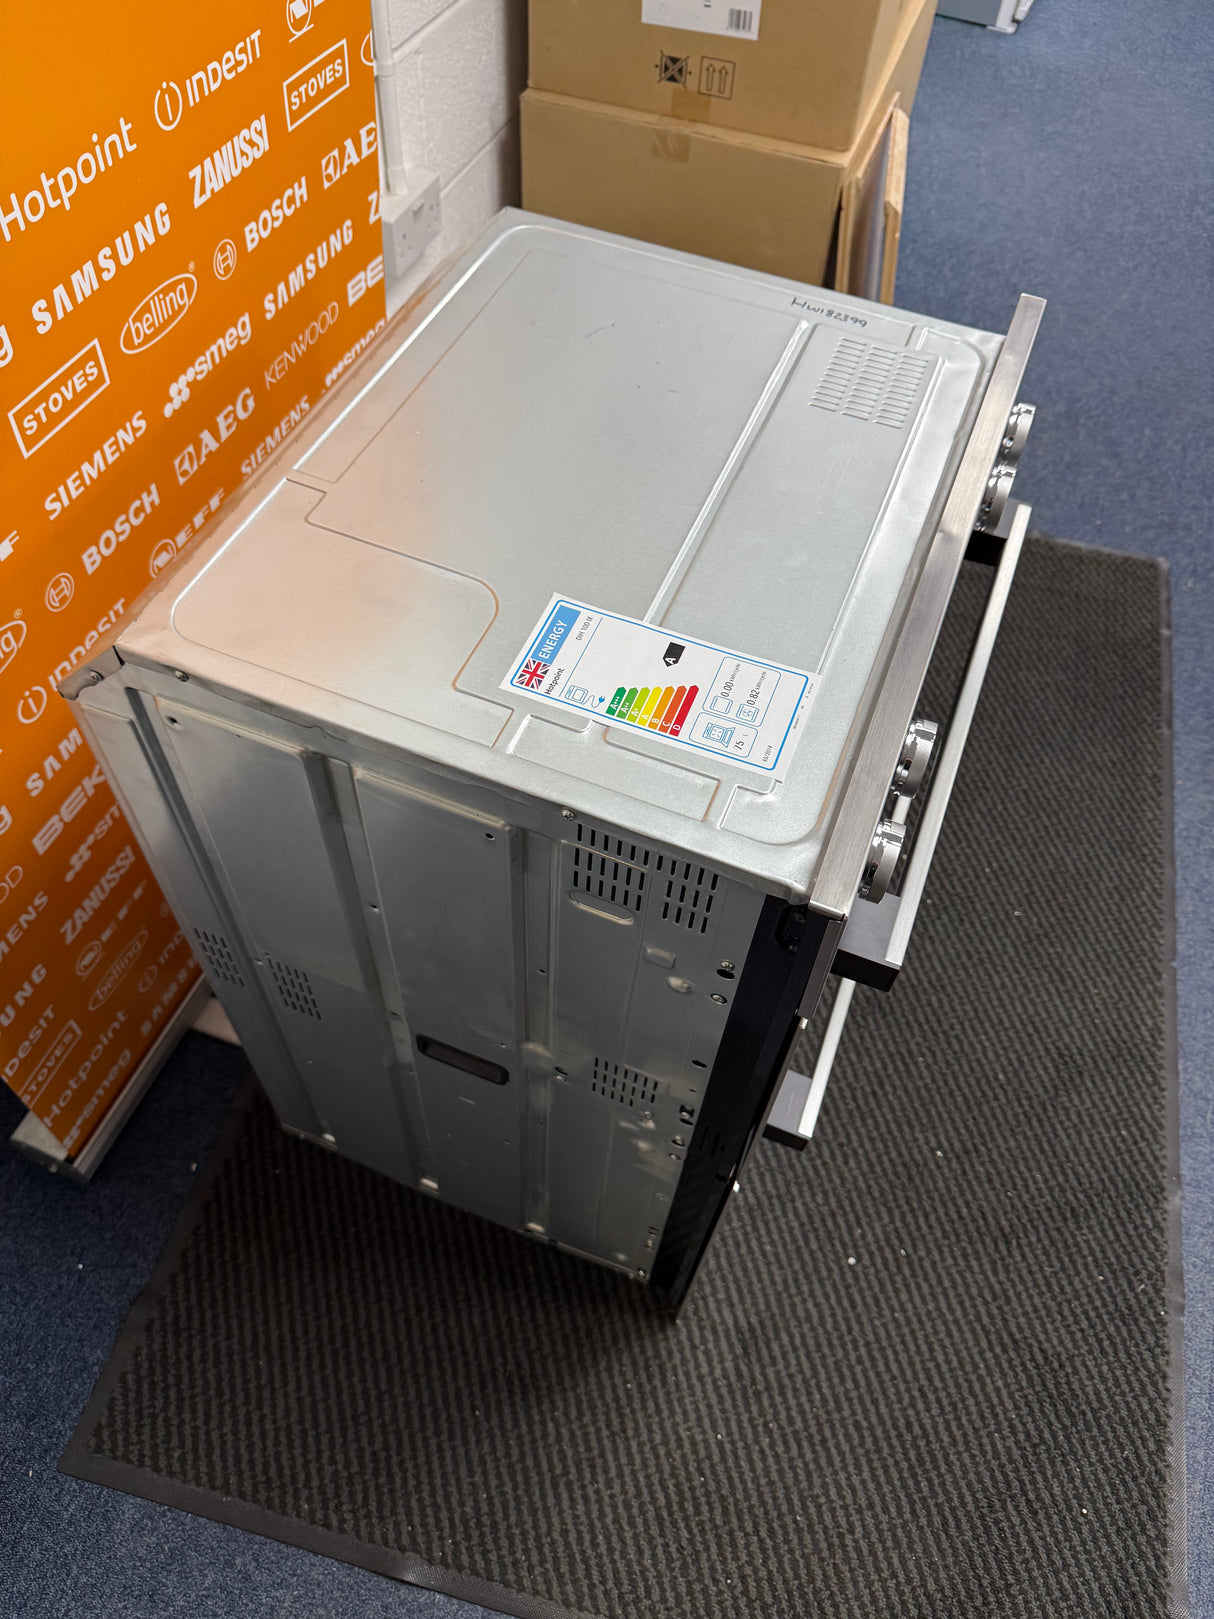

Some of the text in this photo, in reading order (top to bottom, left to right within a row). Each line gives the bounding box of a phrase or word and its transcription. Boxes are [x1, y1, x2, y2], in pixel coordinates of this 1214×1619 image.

[290, 58, 343, 111] STOVES
[0, 117, 137, 242] Hotpoint
[188, 113, 270, 209] ZANUSSI
[244, 176, 308, 253] BOSCH
[32, 202, 171, 335] SAMSUNG
[263, 219, 353, 320] SAMSUNG
[128, 282, 189, 346] belling
[194, 312, 252, 381] smeg
[264, 301, 339, 390] KENWOOD
[23, 361, 99, 435] STOVES
[199, 387, 256, 465] AEG
[44, 410, 147, 521] SIEMENS
[240, 395, 311, 479] SIEMENS
[81, 483, 160, 576] BOSCH
[538, 619, 568, 660] ENERGY
[665, 657, 676, 665] A
[544, 667, 565, 695] Hotpoint
[720, 681, 734, 698] 0.00
[747, 688, 760, 706] 0.82
[60, 845, 136, 945] ZANUSSI
